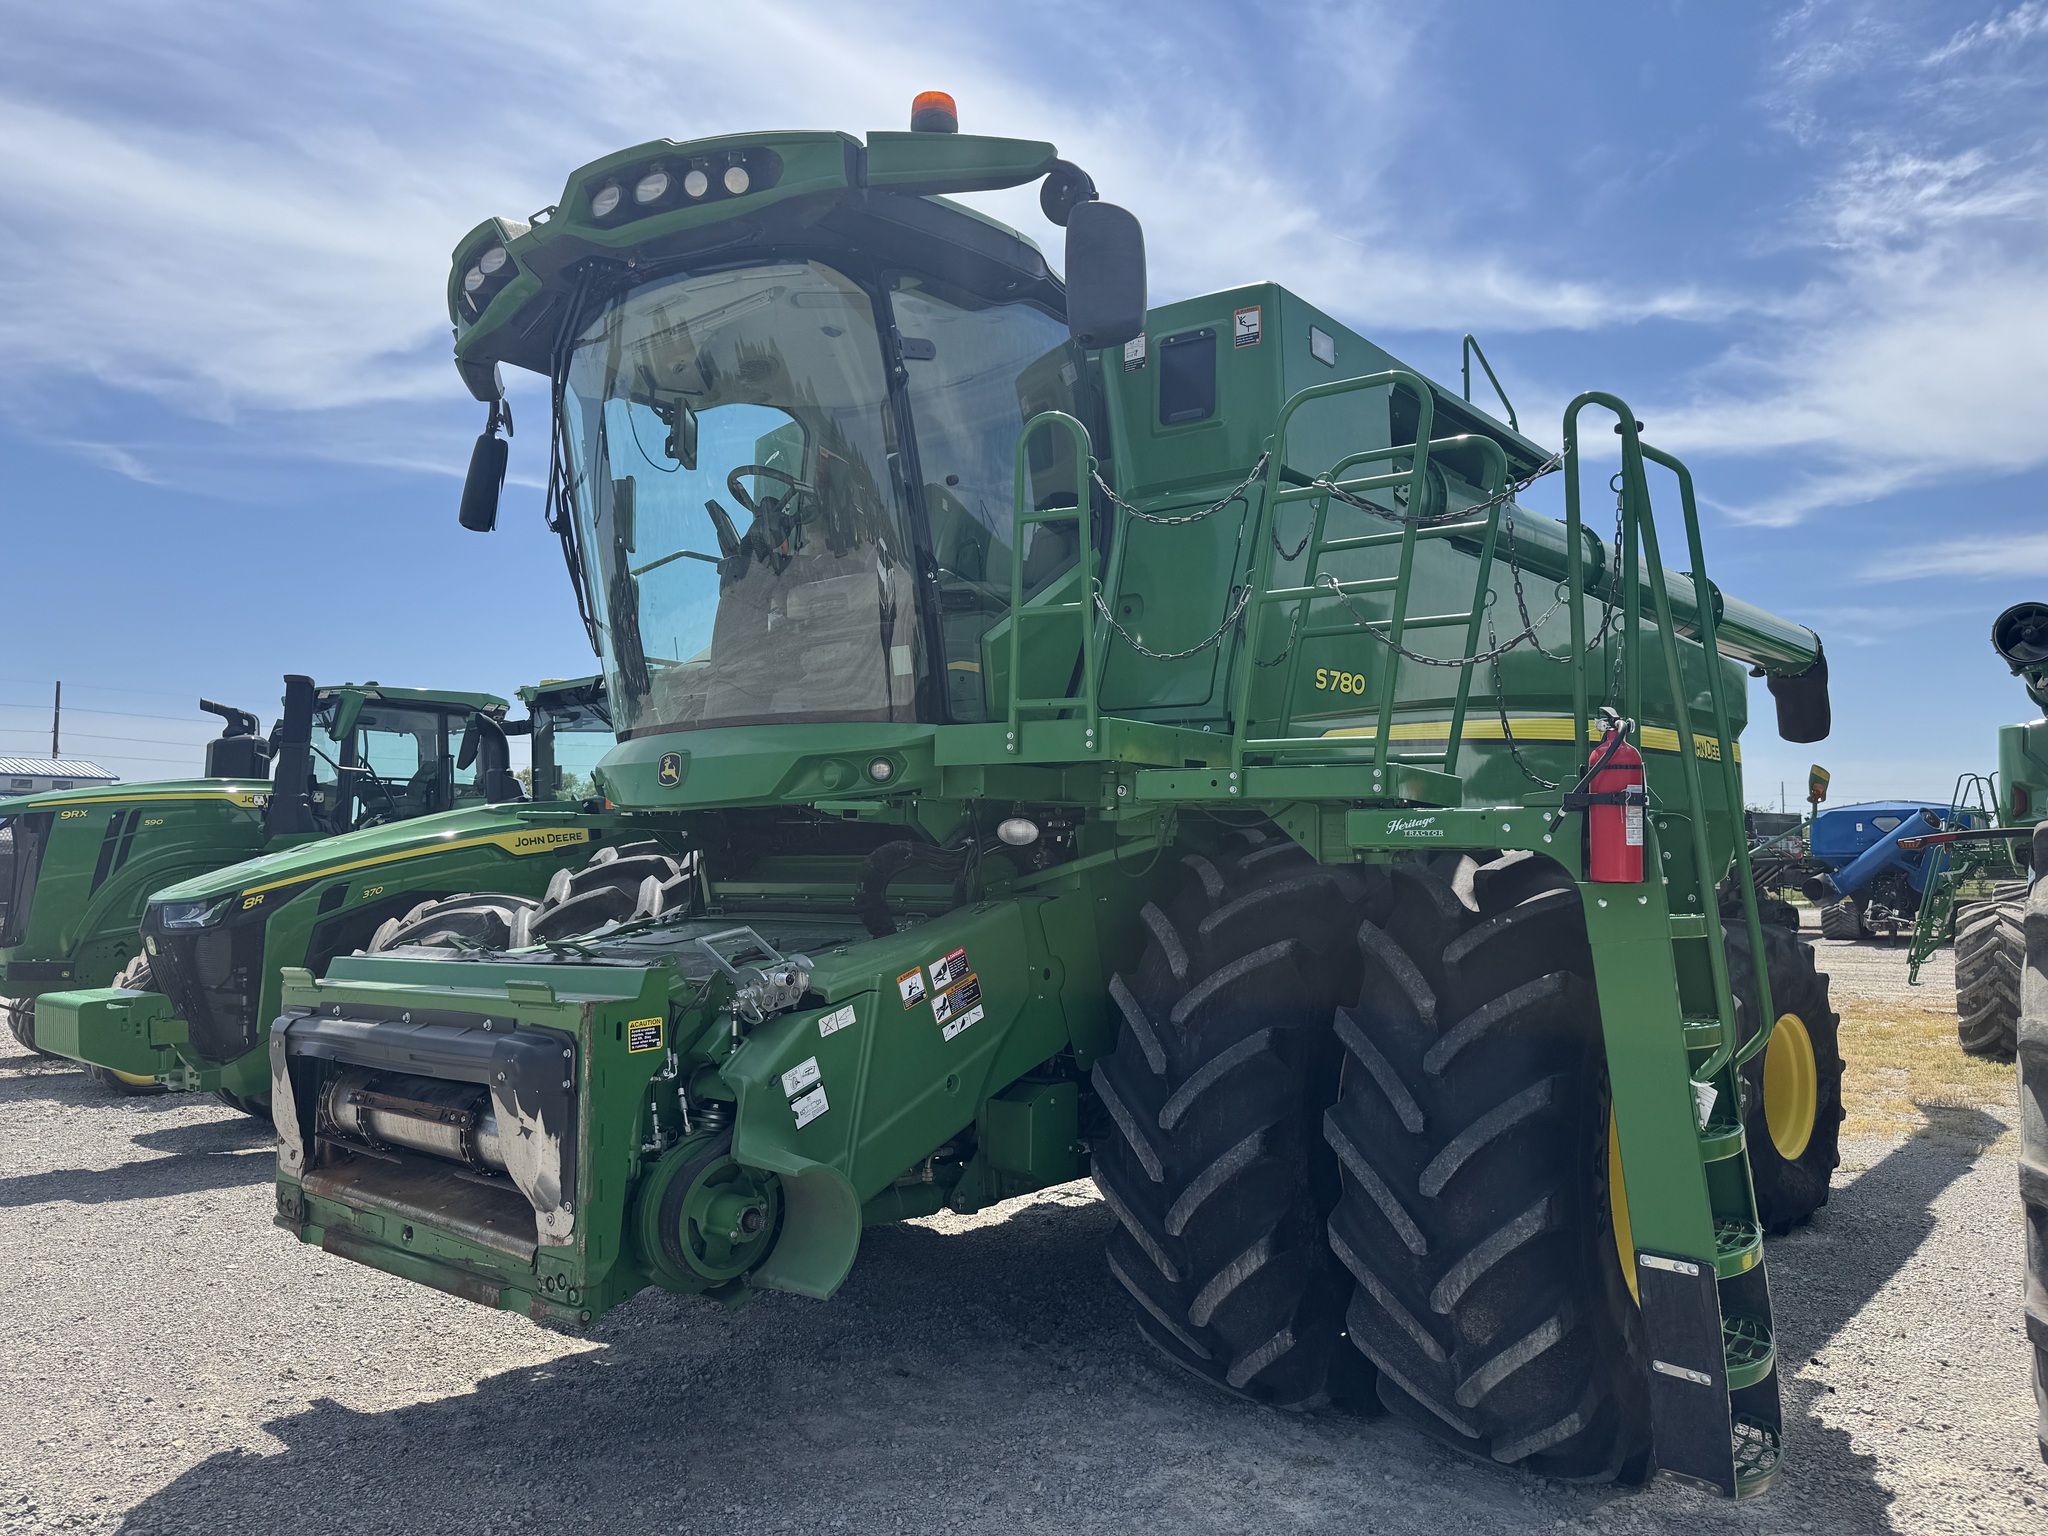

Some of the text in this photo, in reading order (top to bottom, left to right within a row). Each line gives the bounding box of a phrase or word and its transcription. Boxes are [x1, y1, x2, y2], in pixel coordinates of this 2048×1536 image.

[1315, 668, 1365, 695] S780
[60, 809, 88, 820] 9RX
[144, 818, 164, 826] 590
[1386, 816, 1435, 835] Heritage
[515, 832, 583, 847] JOHN DEERE
[1404, 829, 1444, 837] TRACTOR
[362, 886, 384, 899] 370
[242, 894, 265, 910] 8R
[635, 1018, 661, 1027] CAUTION
